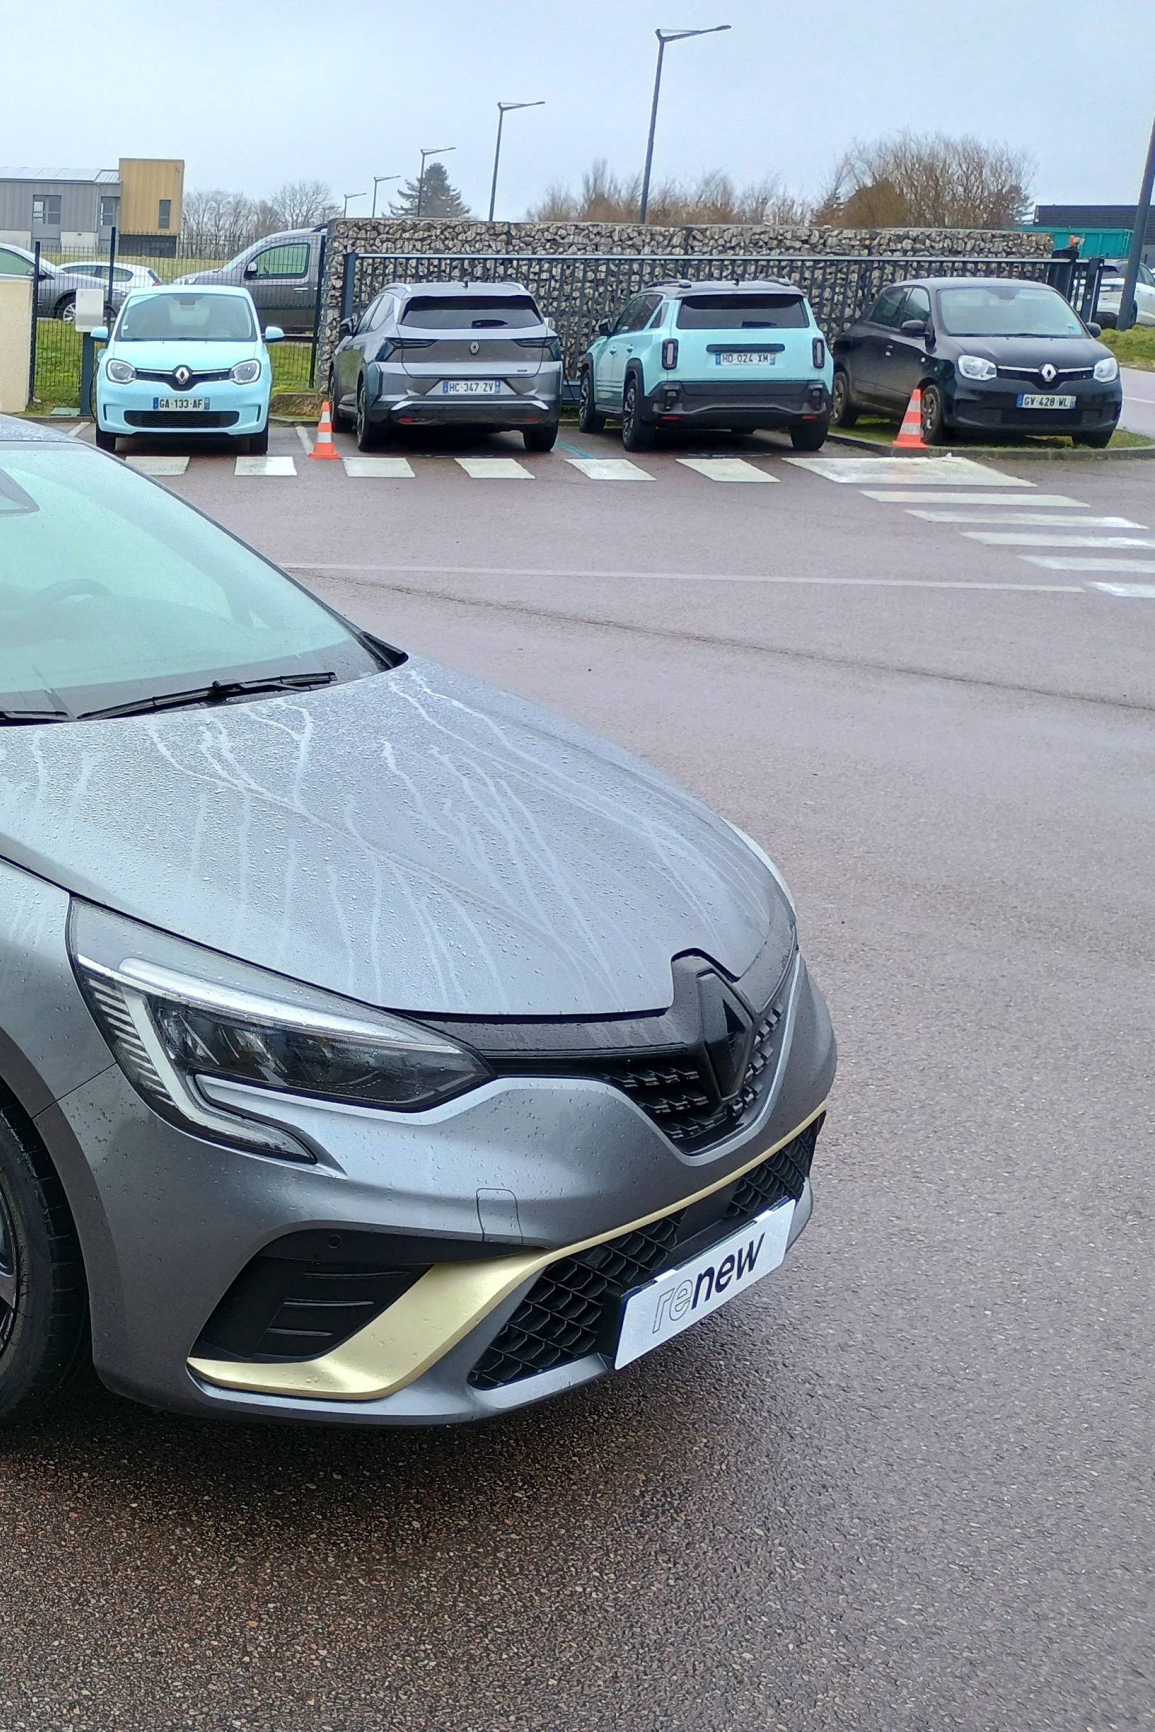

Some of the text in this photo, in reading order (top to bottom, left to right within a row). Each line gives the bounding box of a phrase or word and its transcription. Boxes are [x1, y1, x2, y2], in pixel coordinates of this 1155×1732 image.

[448, 382, 495, 393] HC-347-ZV
[159, 398, 204, 409] GA-133-AF
[651, 1232, 766, 1334] renew
